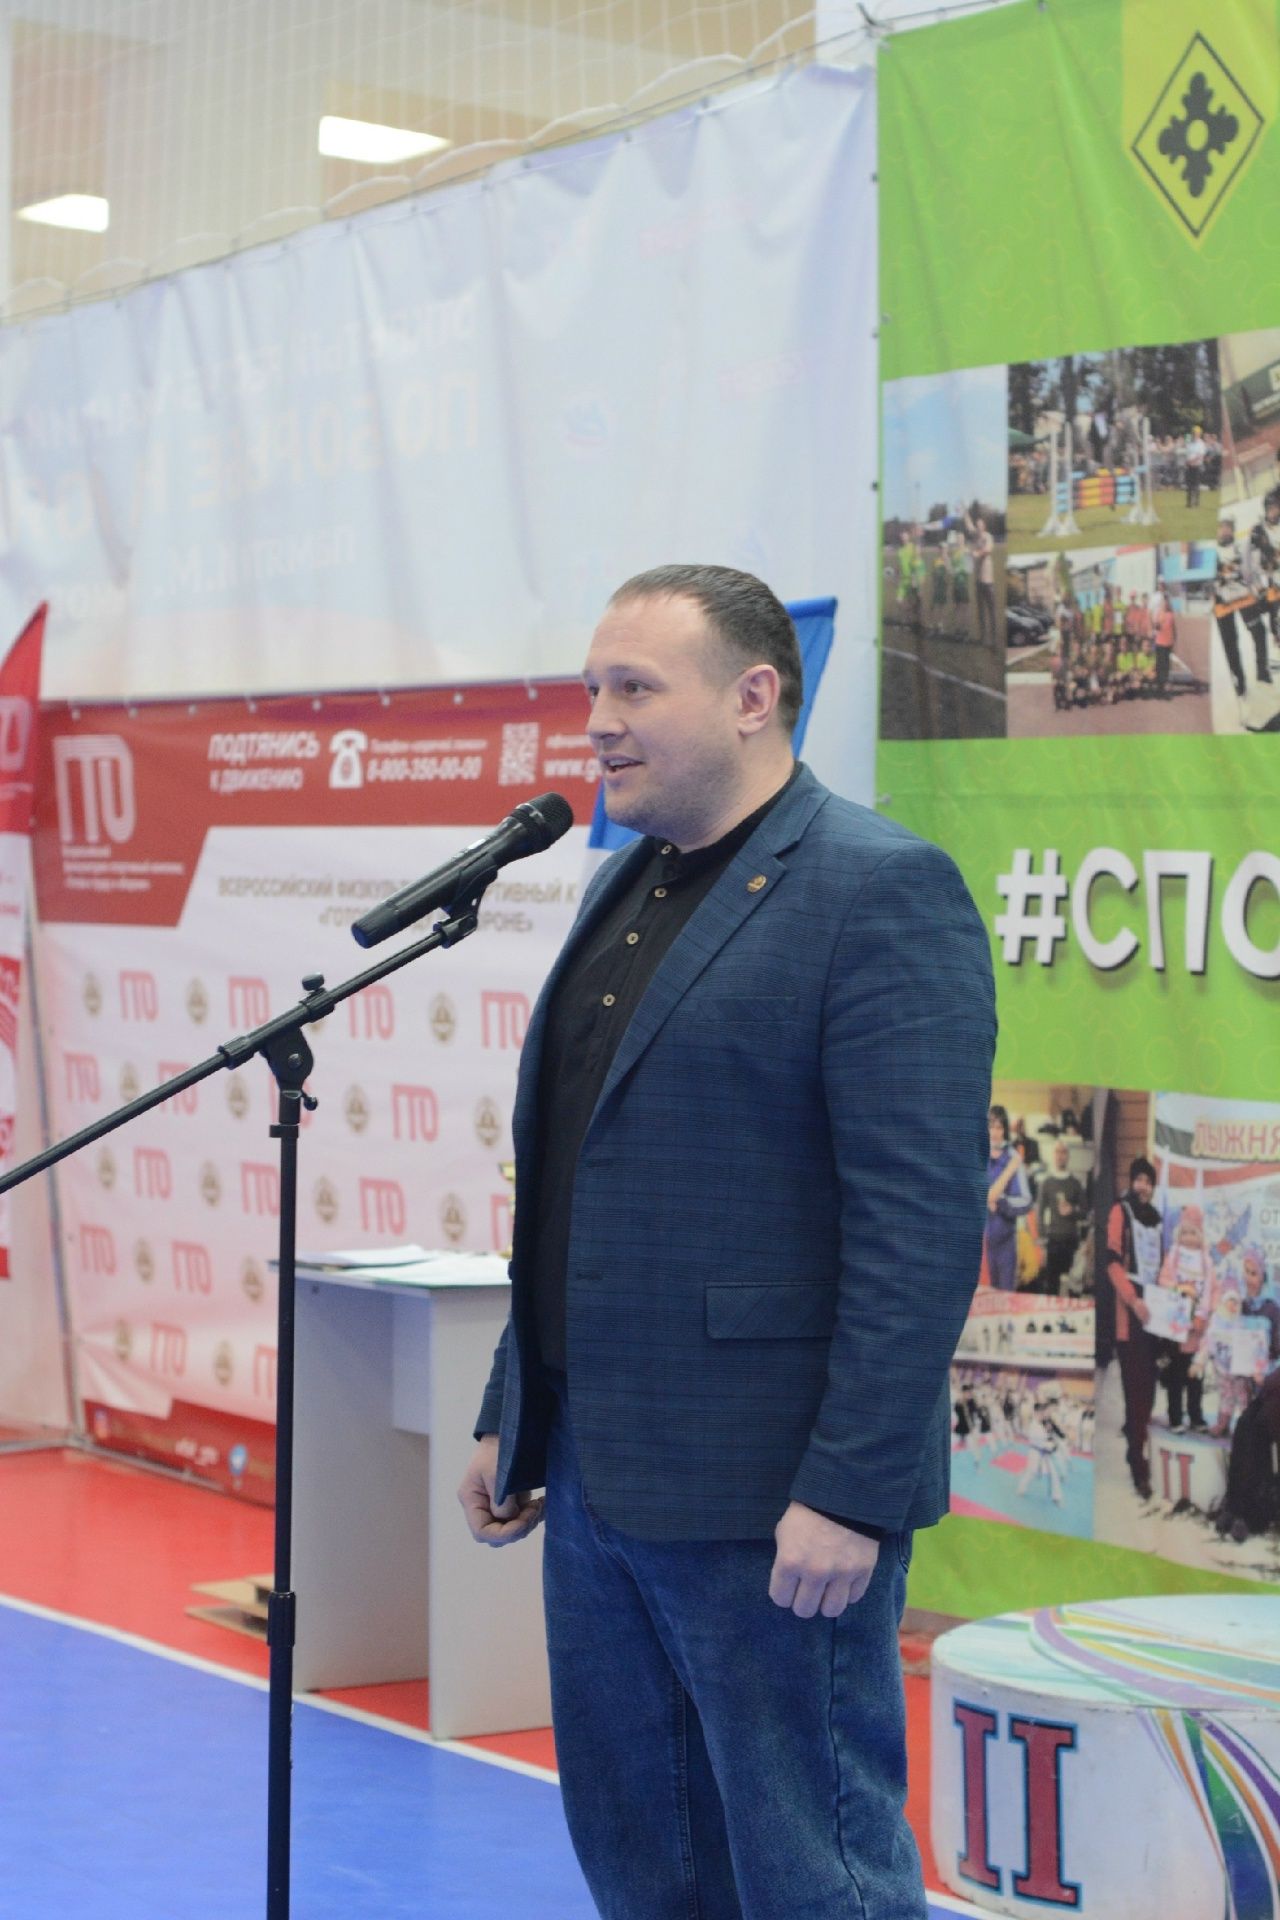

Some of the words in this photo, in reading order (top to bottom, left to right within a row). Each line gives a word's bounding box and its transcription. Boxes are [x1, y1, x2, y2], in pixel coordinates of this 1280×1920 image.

[208, 731, 320, 765] ПОДТЯНИСЬ
[544, 759, 601, 782] www.g
[52, 735, 136, 844] ГТО
[119, 970, 158, 1022] ГТО
[228, 976, 270, 1028] ГТО
[481, 989, 530, 1049] ГТО
[64, 1052, 101, 1103] ГТО
[391, 1083, 440, 1142] ГТО
[134, 1147, 172, 1200] ГТО
[359, 1176, 406, 1236] ГТО
[80, 1223, 117, 1276] ГТО
[171, 1240, 213, 1296] ГТО
[953, 1697, 1082, 1912] II
